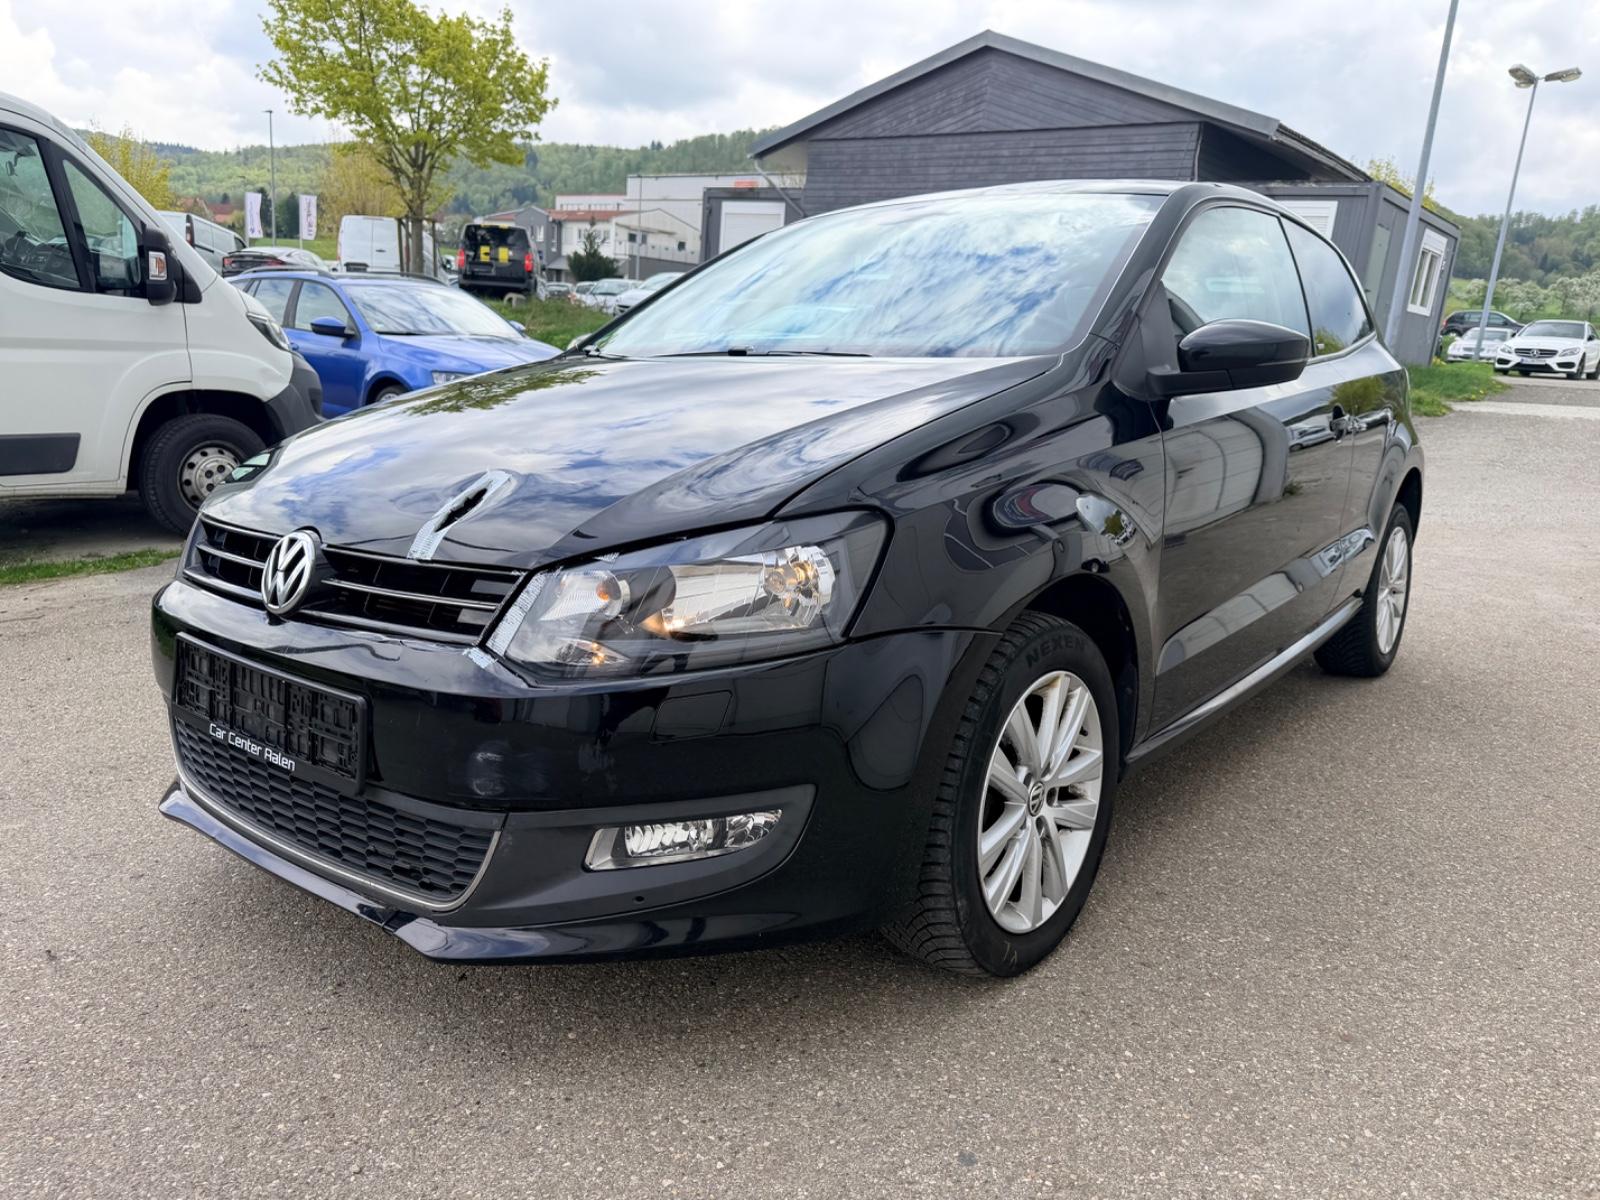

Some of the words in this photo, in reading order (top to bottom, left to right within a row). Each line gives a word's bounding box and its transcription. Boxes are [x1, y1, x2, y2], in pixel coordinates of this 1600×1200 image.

[1025, 634, 1085, 669] NEXEN
[209, 723, 226, 740] Car
[228, 731, 262, 756] Center
[264, 747, 296, 772] Aalen
